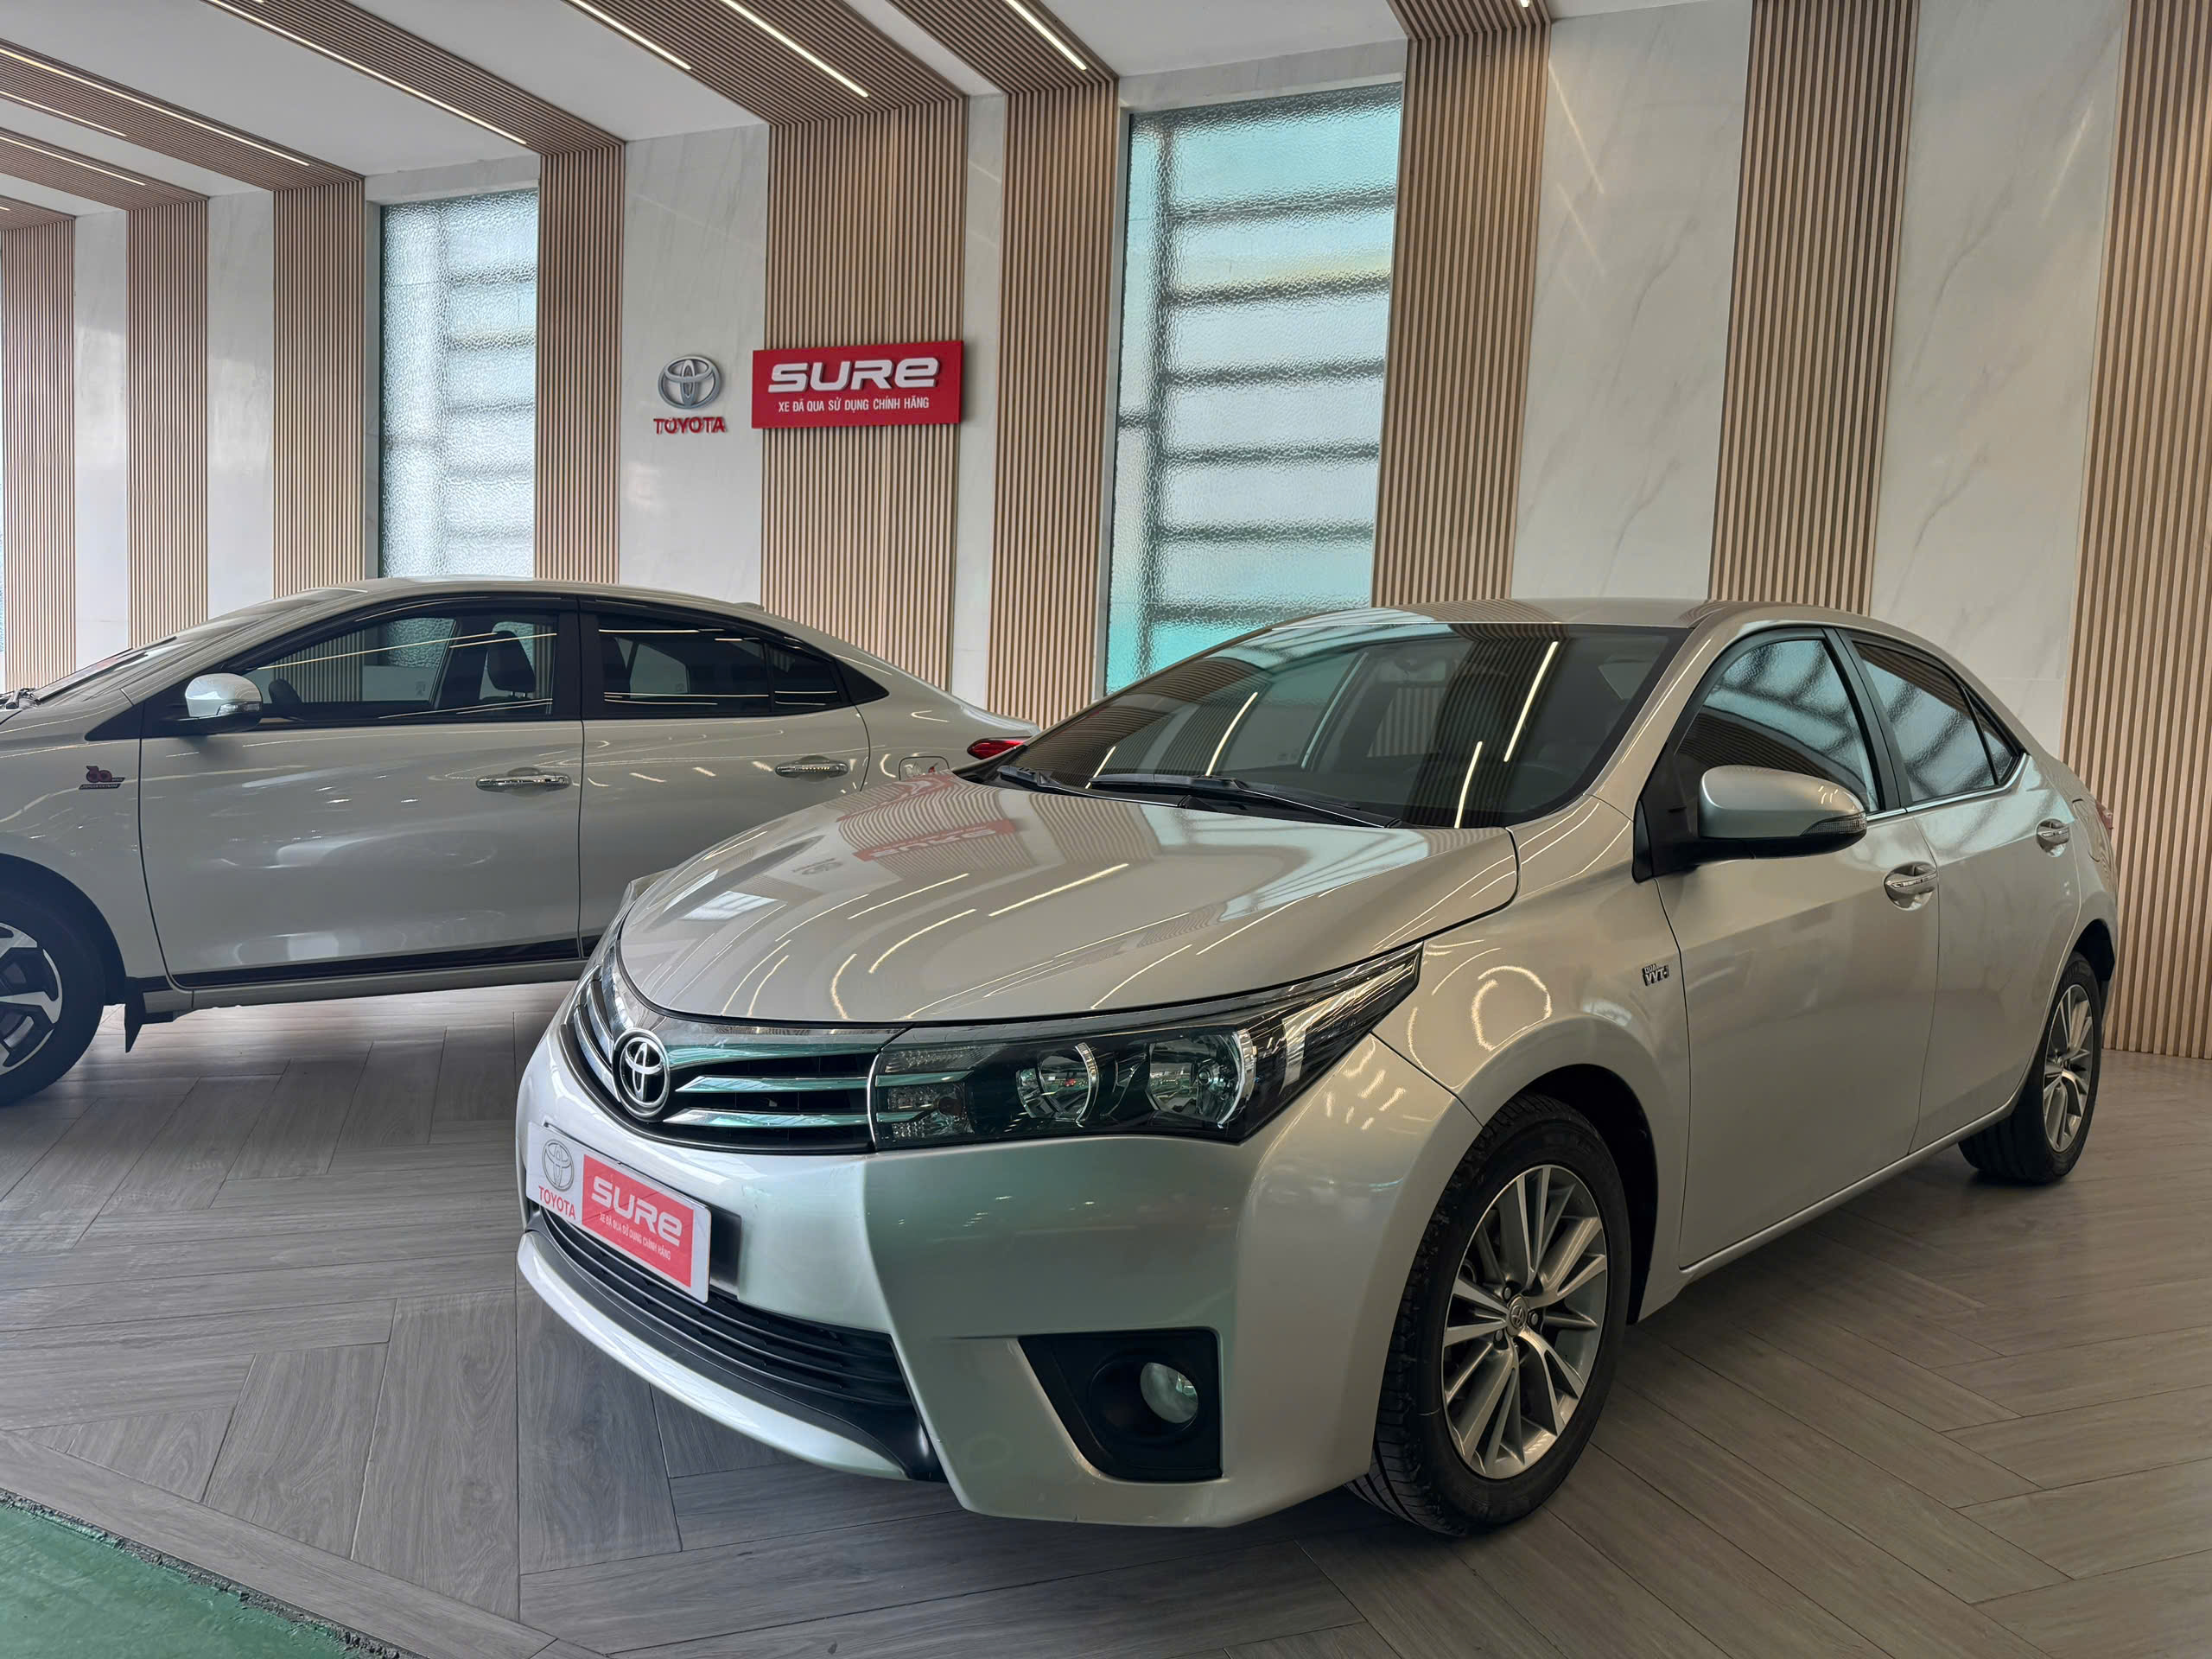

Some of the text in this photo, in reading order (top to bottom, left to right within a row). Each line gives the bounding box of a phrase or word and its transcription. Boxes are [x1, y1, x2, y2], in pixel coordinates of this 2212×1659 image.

[779, 401, 790, 413] XE
[807, 400, 825, 413] QUA
[828, 397, 842, 411] SỬ
[844, 398, 869, 413] DỤNG
[873, 395, 900, 410] CHÍNH
[653, 416, 726, 435] TOYOTA
[538, 1185, 576, 1220] TOYOTA
